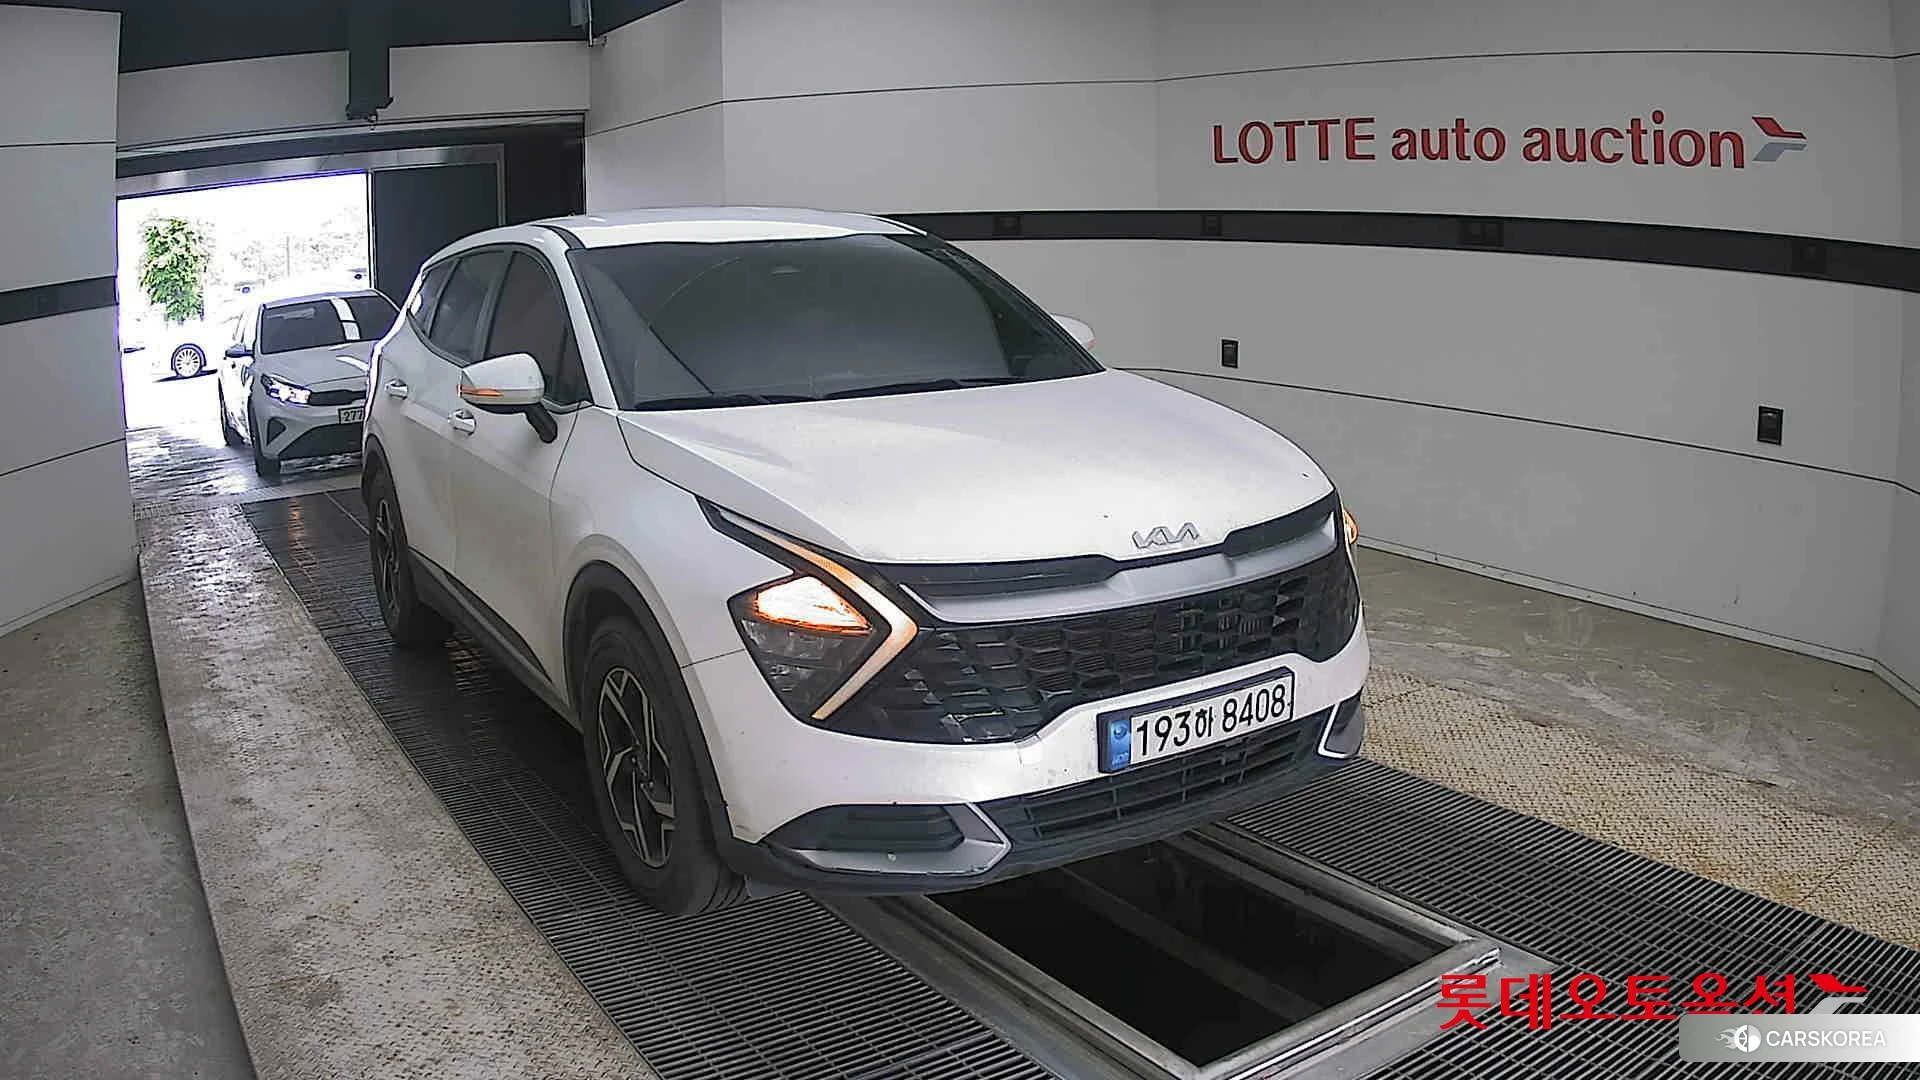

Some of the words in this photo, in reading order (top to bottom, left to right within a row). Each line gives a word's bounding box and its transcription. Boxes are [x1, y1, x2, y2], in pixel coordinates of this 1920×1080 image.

[1212, 117, 1376, 164] LOTTE
[1391, 118, 1506, 163] auto
[1522, 110, 1746, 168] auction
[1132, 522, 1199, 549] KIA
[1136, 706, 1214, 756] 193하
[1222, 684, 1286, 733] 8408
